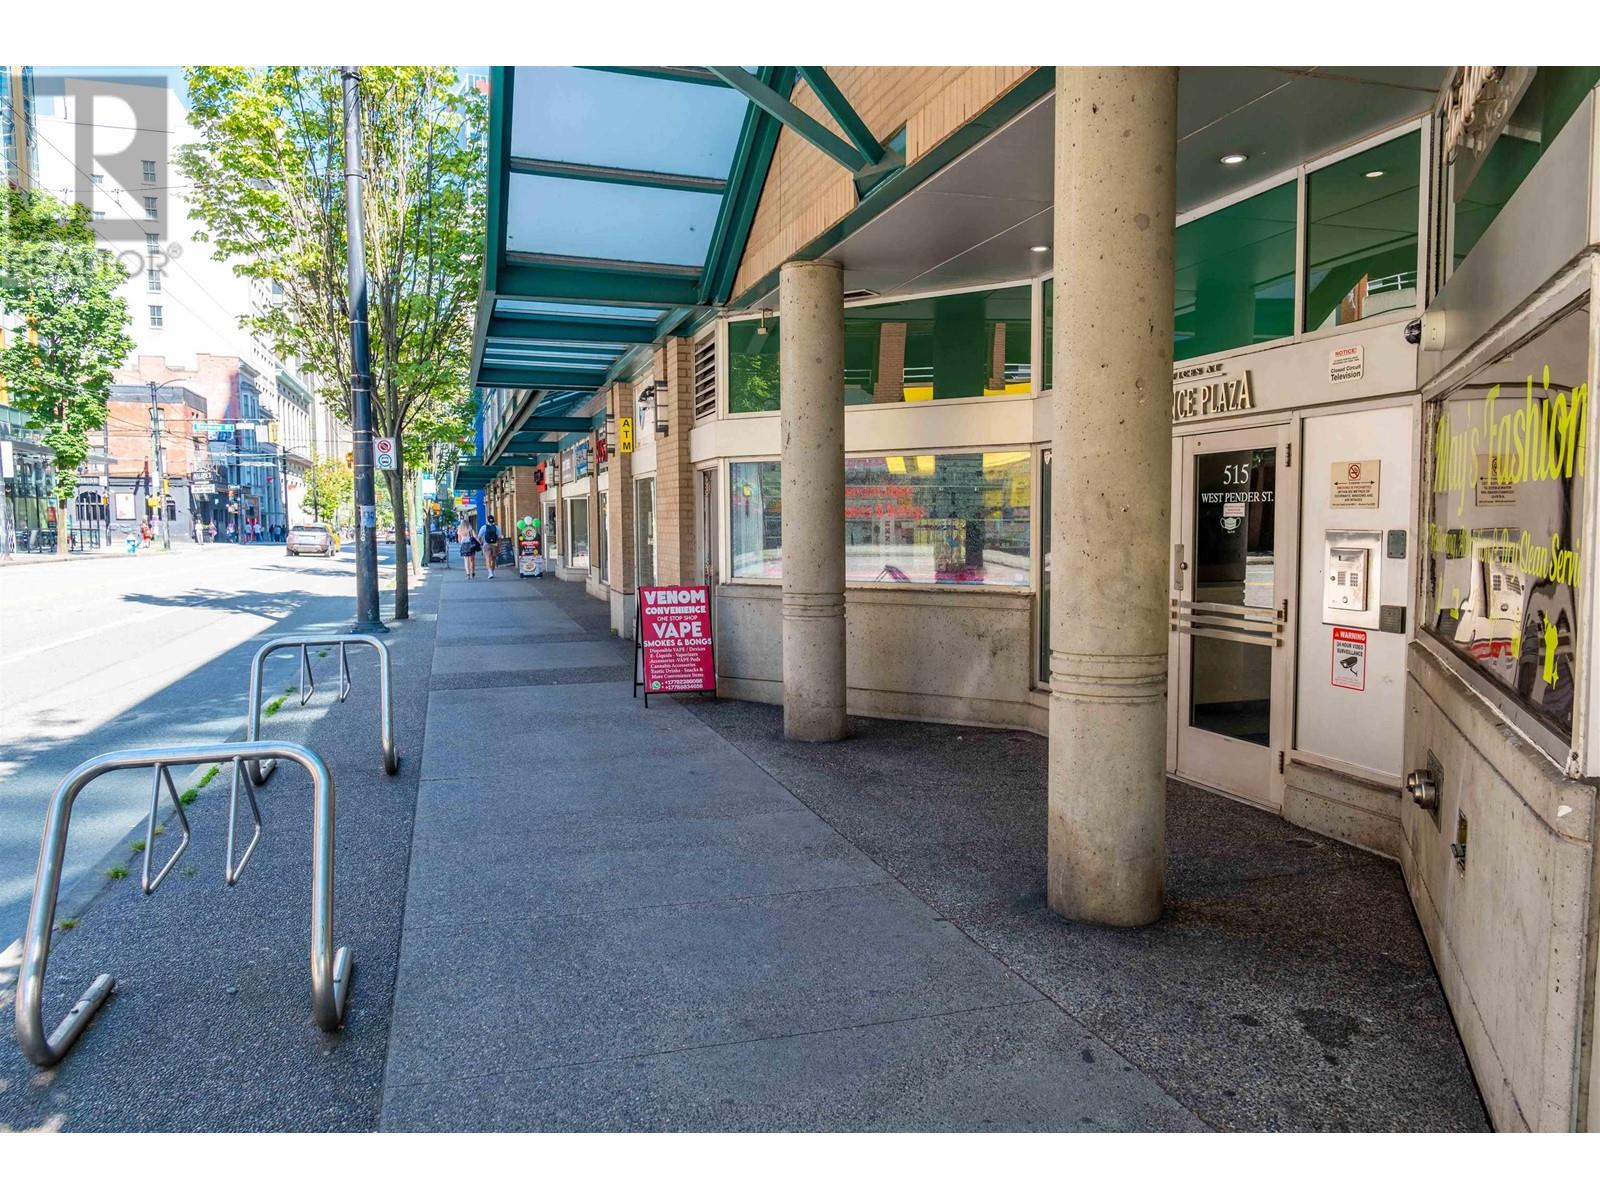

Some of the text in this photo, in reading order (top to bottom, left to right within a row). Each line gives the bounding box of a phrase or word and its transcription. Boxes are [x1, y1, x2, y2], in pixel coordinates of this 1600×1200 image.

[1330, 371, 1361, 381] Television
[1200, 370, 1253, 415] PLAZA
[622, 418, 632, 451] ATM
[1434, 364, 1588, 517] May's Fashion
[1223, 463, 1249, 485] 515
[1201, 491, 1274, 503] WEST PENDER ST.
[1519, 530, 1548, 580] Clean
[644, 590, 706, 605] VENOM
[645, 605, 707, 615] CONVENIENCE
[652, 622, 703, 638] VAPE
[1340, 631, 1366, 641] WARNING
[644, 640, 675, 648] SMOKES
[684, 638, 712, 646] BONGS
[1336, 648, 1364, 657] SURVEILLANCE
